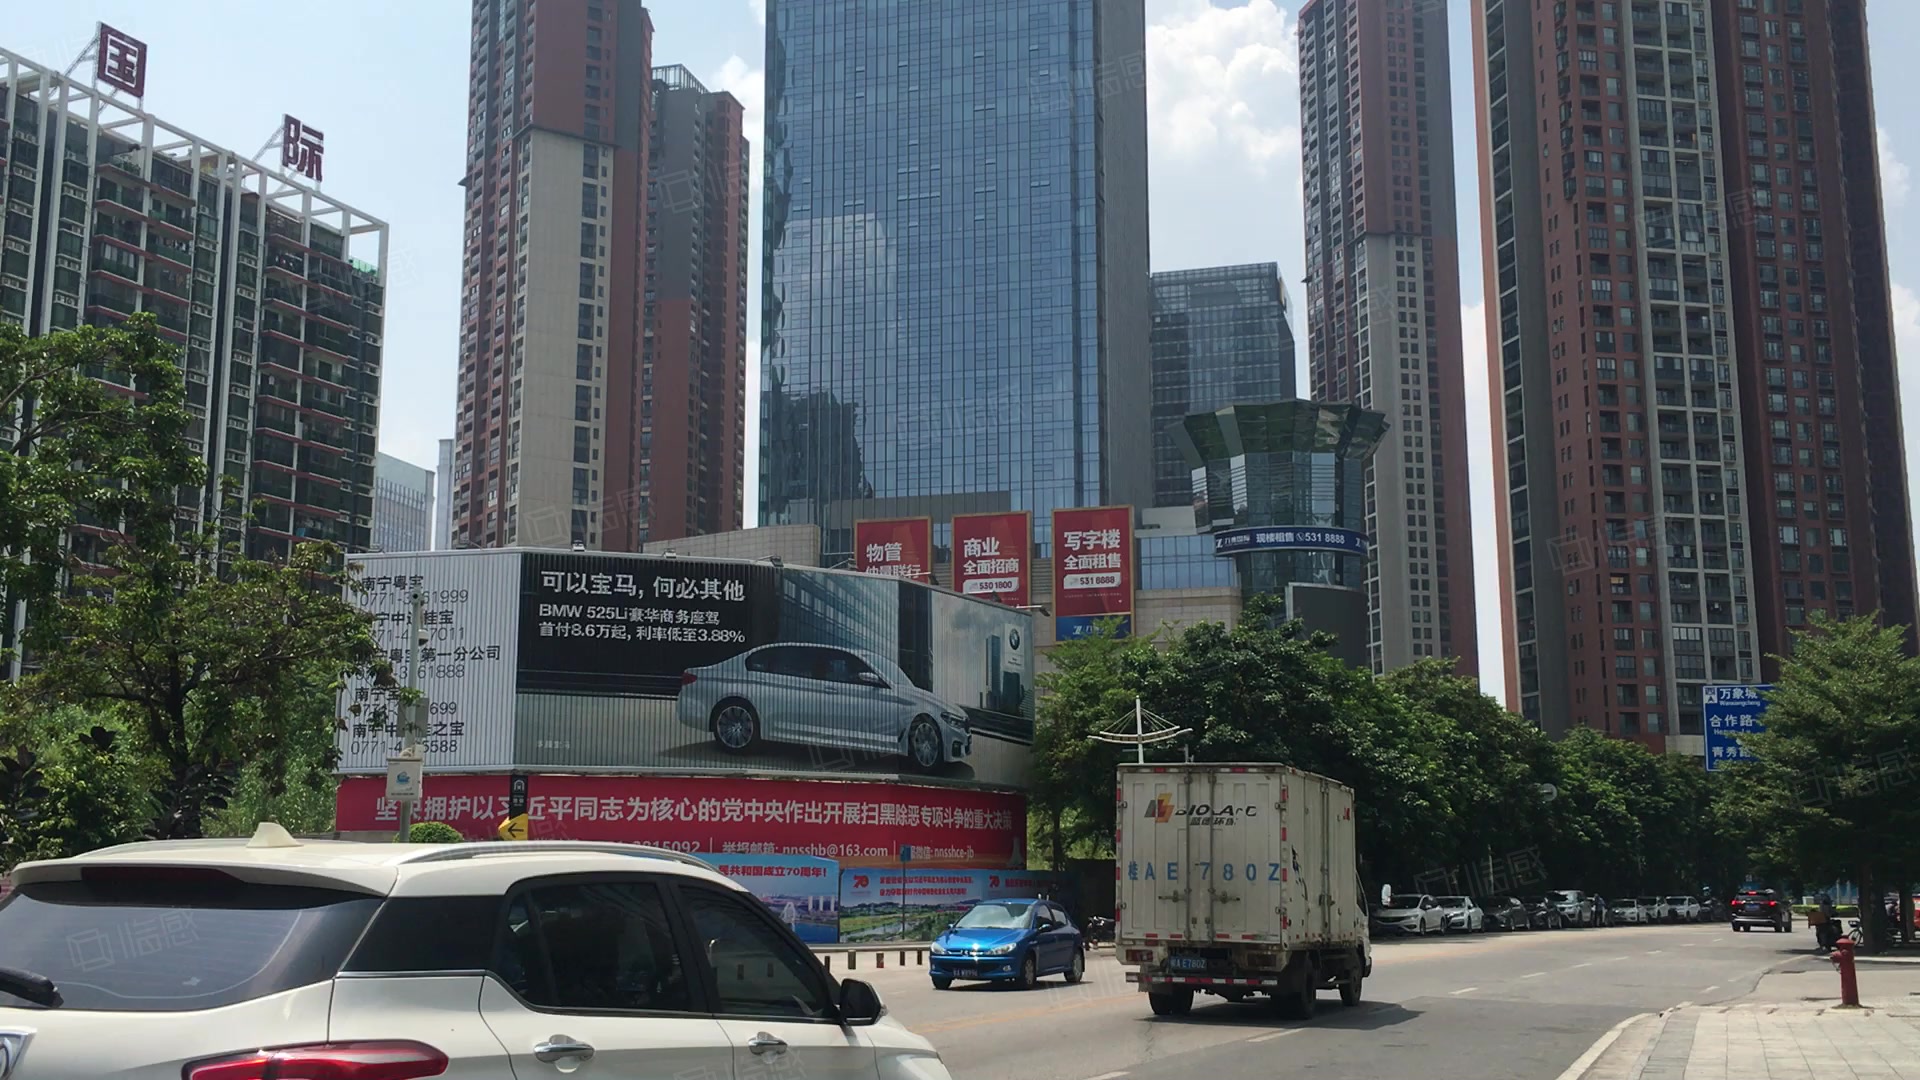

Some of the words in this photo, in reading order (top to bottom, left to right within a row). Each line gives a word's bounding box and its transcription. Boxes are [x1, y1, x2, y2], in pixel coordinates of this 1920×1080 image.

[97, 22, 147, 98] 国
[281, 113, 324, 182] 际
[963, 537, 1000, 558] 商业
[1063, 529, 1120, 551] 写字楼
[866, 542, 902, 562] 物管
[1063, 552, 1121, 570] 全面租售
[963, 558, 1019, 576] 全面招商
[362, 574, 424, 591] 南宁粤宝
[360, 589, 469, 606] 0771-361999
[539, 603, 583, 618] BMW
[1709, 714, 1753, 728] 合作路
[351, 740, 457, 755] 0771-45588
